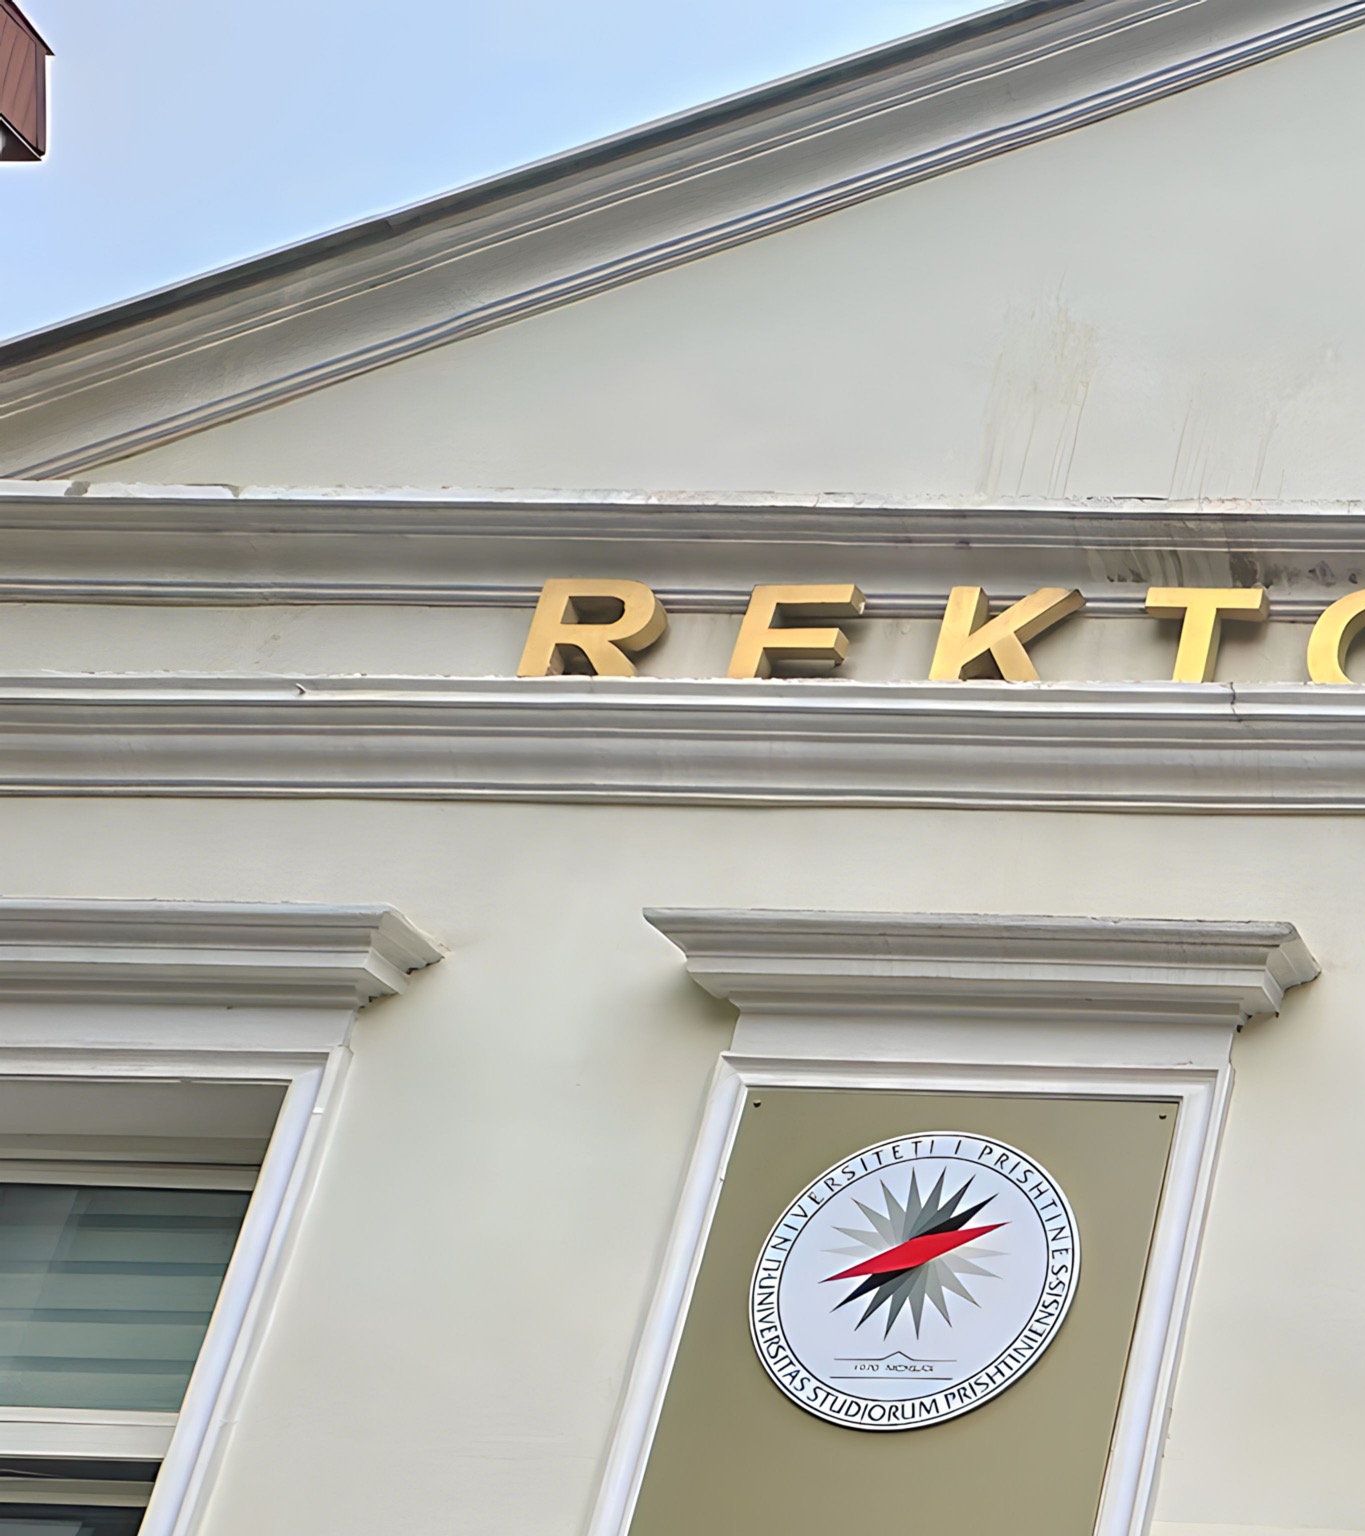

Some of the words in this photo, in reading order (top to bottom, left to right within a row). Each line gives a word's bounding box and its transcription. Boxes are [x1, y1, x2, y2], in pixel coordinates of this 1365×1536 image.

[762, 1139, 936, 1272] UNIVERSITETI
[756, 1275, 811, 1392] UNIVERSITAS
[806, 1385, 940, 1423] STUDIORUM
[943, 1279, 1066, 1411] PRISHTINIENSIS
